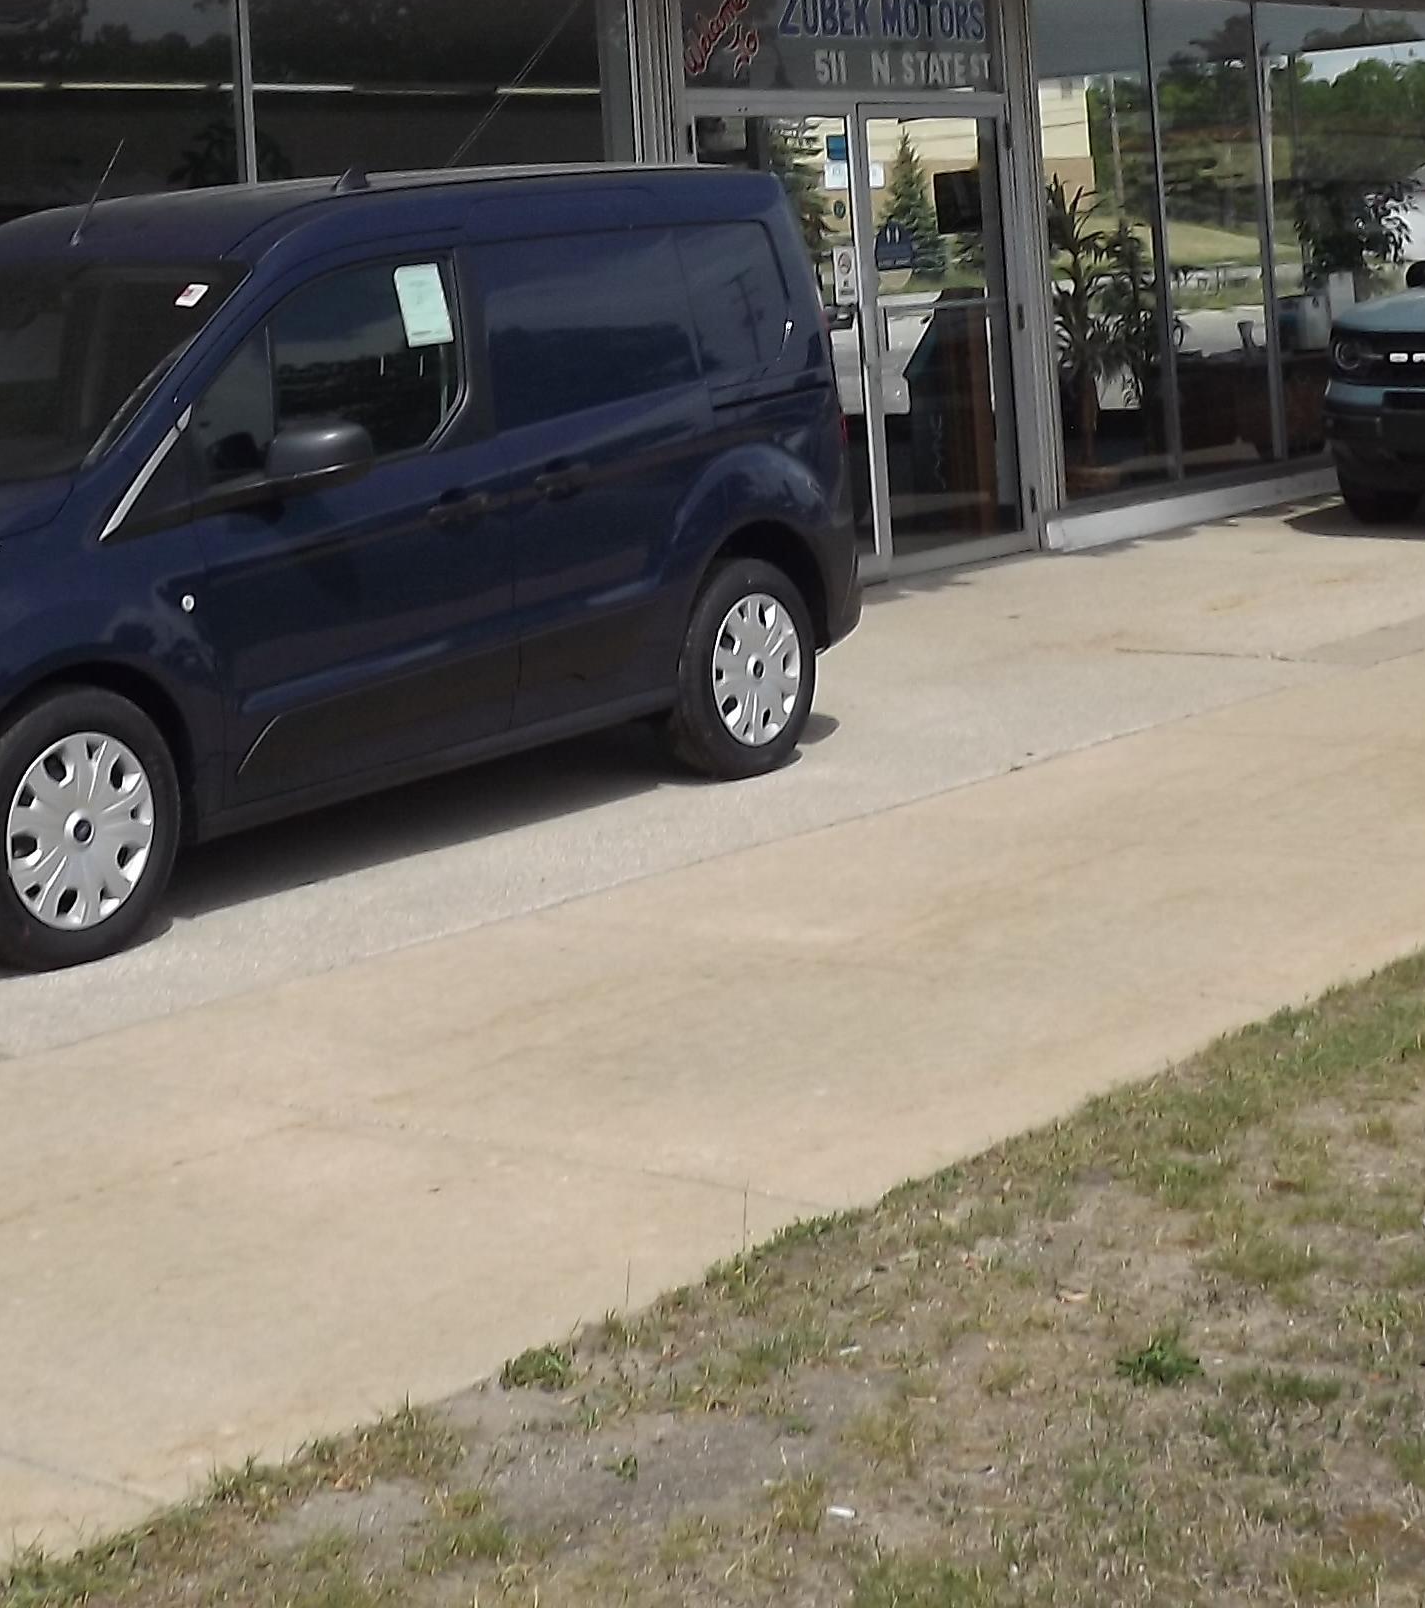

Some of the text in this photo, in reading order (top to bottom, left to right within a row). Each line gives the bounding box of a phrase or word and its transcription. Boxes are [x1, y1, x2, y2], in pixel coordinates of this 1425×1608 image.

[813, 49, 848, 85] 511
[901, 50, 967, 85] STATE
[970, 52, 992, 80] ST
